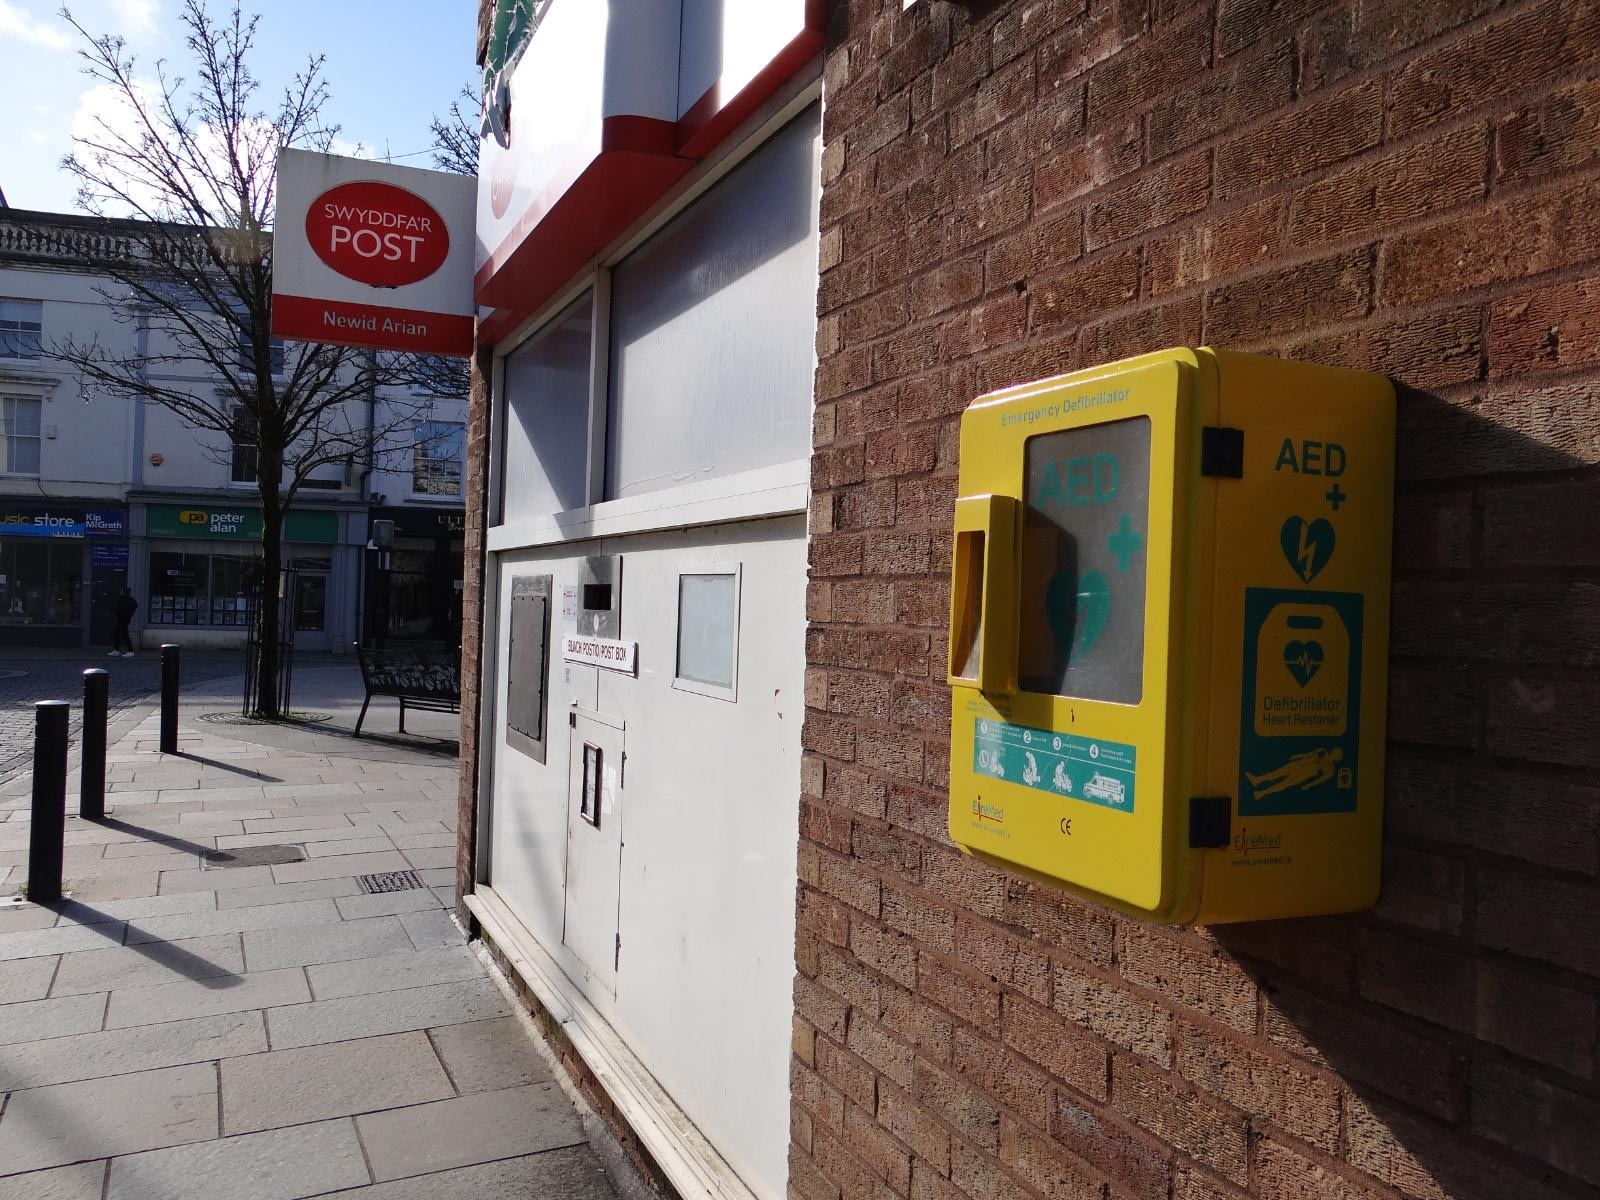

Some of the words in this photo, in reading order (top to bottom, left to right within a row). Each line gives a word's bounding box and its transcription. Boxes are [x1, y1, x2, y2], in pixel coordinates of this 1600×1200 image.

[324, 203, 432, 233] SWYDDFA'R
[330, 225, 425, 263] POST
[323, 310, 377, 331] Newid
[382, 318, 427, 336] Arian
[1001, 403, 1061, 426] Emergency
[1063, 389, 1131, 413] Defibrillator
[1274, 438, 1346, 477] AED
[1036, 452, 1121, 509] AED
[34, 512, 75, 527] store
[86, 513, 101, 524] Kip
[86, 521, 122, 529] McGrath
[189, 513, 205, 523] pa
[210, 513, 245, 524] peter
[210, 522, 237, 533] alan
[1263, 696, 1341, 711] Defibrillator
[1262, 713, 1291, 725] Heart
[1294, 713, 1341, 726] Restarter
